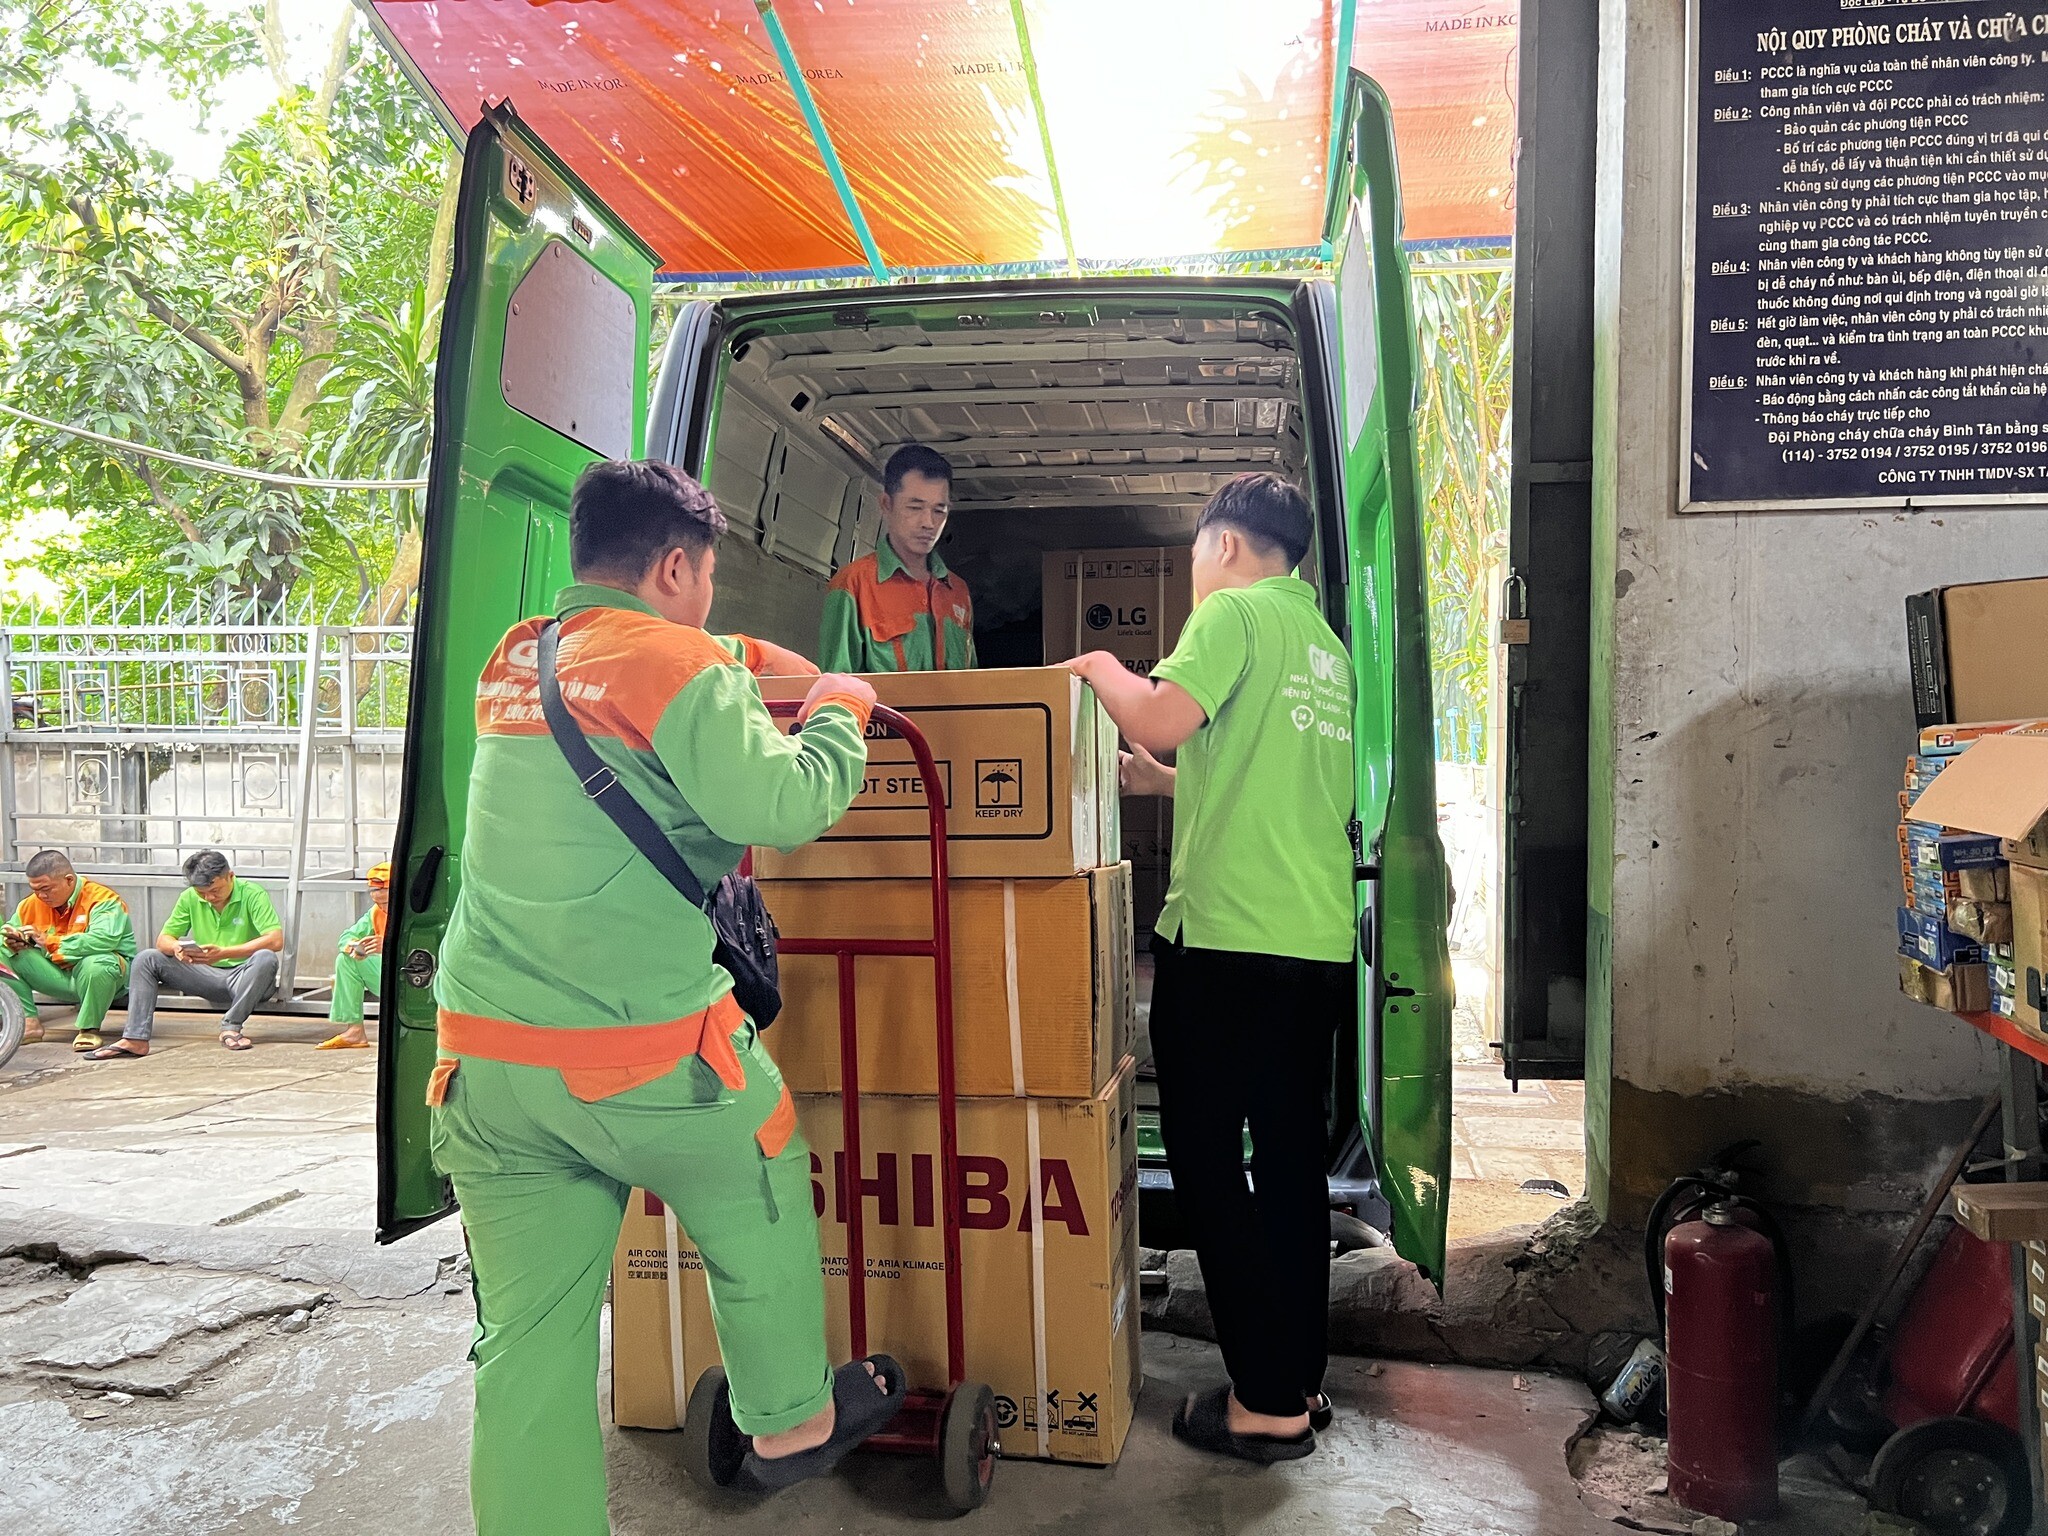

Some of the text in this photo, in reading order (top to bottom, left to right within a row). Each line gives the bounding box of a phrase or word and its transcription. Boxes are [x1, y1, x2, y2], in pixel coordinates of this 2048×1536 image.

[1426, 19, 1473, 33] MADE
[1476, 17, 1493, 28] IN
[1756, 26, 1787, 56] NỘI
[1791, 28, 1827, 50] QUY
[1831, 20, 1890, 47] PHÒNG
[1895, 16, 1944, 43] CHÁY
[1947, 14, 1972, 40] VÀ
[1976, 12, 2027, 42] CHỮA
[952, 63, 996, 75] MADE
[1714, 67, 1739, 82] Điều
[1742, 70, 1752, 82] 1:
[1760, 62, 1793, 79] PCCC
[1796, 64, 1806, 76] là
[1809, 63, 1840, 78] nghĩa
[1843, 64, 1857, 75] vụ
[1859, 59, 1880, 72] của
[1882, 58, 1907, 71] toàn
[1910, 54, 1928, 70] thể
[1931, 56, 1959, 68] nhân
[1962, 54, 1986, 67] viên
[1989, 53, 2018, 67] công
[2020, 53, 2035, 66] ty.
[537, 79, 577, 93] MADE
[593, 78, 628, 92] KOR
[735, 73, 777, 85] MADE
[1760, 79, 1892, 99] tham gia tích cực PCCC
[1714, 91, 2044, 121] Điều 2: Công nhân viên và đội PCCC phải có trách nhiệm:
[1712, 202, 1738, 216] Điều
[1740, 203, 1751, 215] 3:
[1759, 200, 1789, 213] Nhân
[1792, 199, 1816, 211] viên
[1819, 197, 1848, 211] công
[1851, 197, 1862, 210] ty
[1865, 193, 1890, 210] phải
[1893, 193, 1914, 206] tích
[1917, 193, 1938, 206] cực
[1941, 191, 1970, 203] tham
[1973, 190, 1990, 205] gia
[1993, 189, 2015, 203] học
[2018, 188, 2040, 202] tập,
[1758, 231, 1932, 253] cùng tham gia công tác PCCC.
[1756, 350, 1841, 367] trước khi ra về.
[1709, 362, 2048, 388] Điều 6: Nhân viên công ty và khách hàng khi phát hiện chá
[1768, 431, 1790, 445] Đội
[1793, 429, 1835, 443] Phòng
[1838, 427, 1870, 442] cháy
[1872, 426, 1904, 439] chữa
[1908, 425, 1939, 439] cháy
[1943, 424, 1973, 436] Bình
[1976, 423, 2001, 435] Tân
[2005, 419, 2038, 436] bằng
[1782, 448, 1814, 463] (114)
[1826, 447, 1857, 460] 3752
[1860, 446, 1892, 458] 0194
[1903, 445, 1935, 457] 3752
[1938, 443, 1969, 456] 0195
[1980, 442, 2012, 454] 3752
[2015, 441, 2047, 453] 0196
[1878, 468, 1915, 483] CÔNG
[1918, 469, 1935, 481] TY
[1938, 468, 1974, 481] TNHH
[1976, 466, 2034, 479] TMDV-SX
[1118, 607, 1147, 626] LG
[507, 639, 539, 669] G
[1120, 659, 1157, 674] RAT
[864, 723, 888, 737] ON
[886, 777, 925, 794] STE
[975, 809, 1023, 818] KEEP DRY
[628, 1249, 643, 1258] AIR
[878, 1259, 901, 1269] ARIA
[902, 1260, 945, 1271] KLIMAGE
